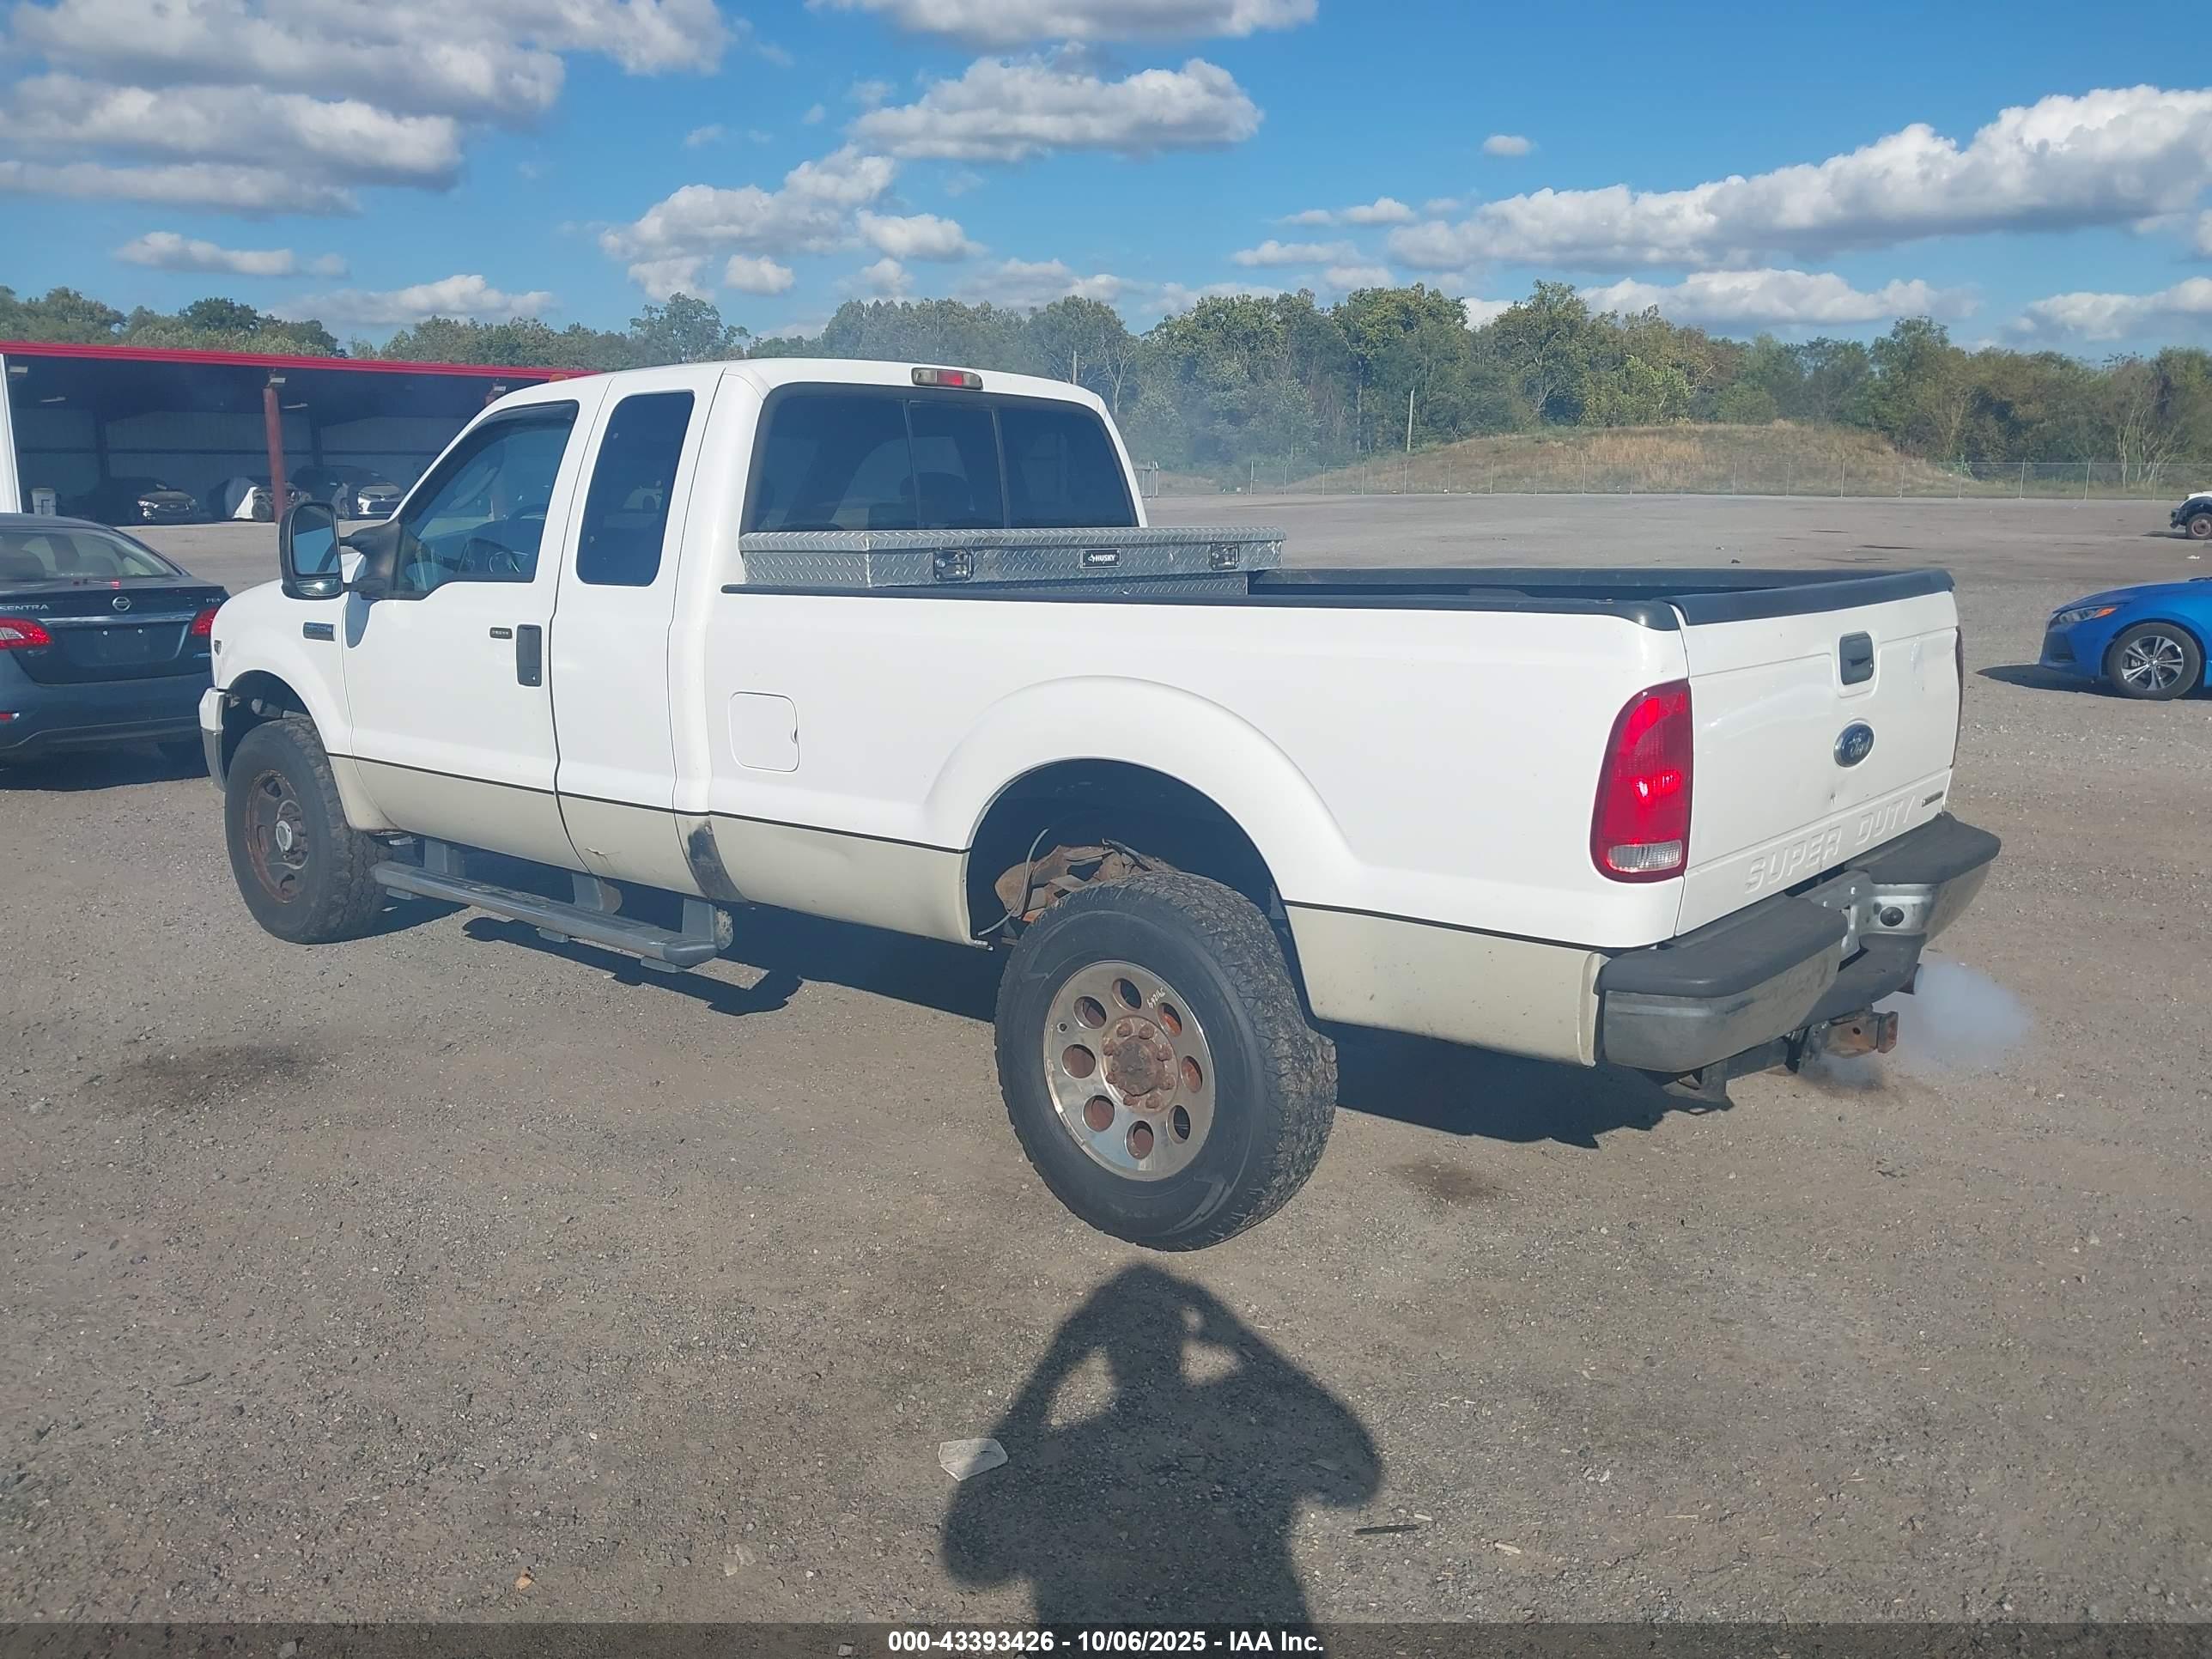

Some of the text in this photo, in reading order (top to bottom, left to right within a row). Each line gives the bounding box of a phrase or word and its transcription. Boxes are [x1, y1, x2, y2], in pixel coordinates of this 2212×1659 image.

[1095, 554, 1115, 562] HUSKY
[1745, 795, 1917, 894] SUPER DUTY
